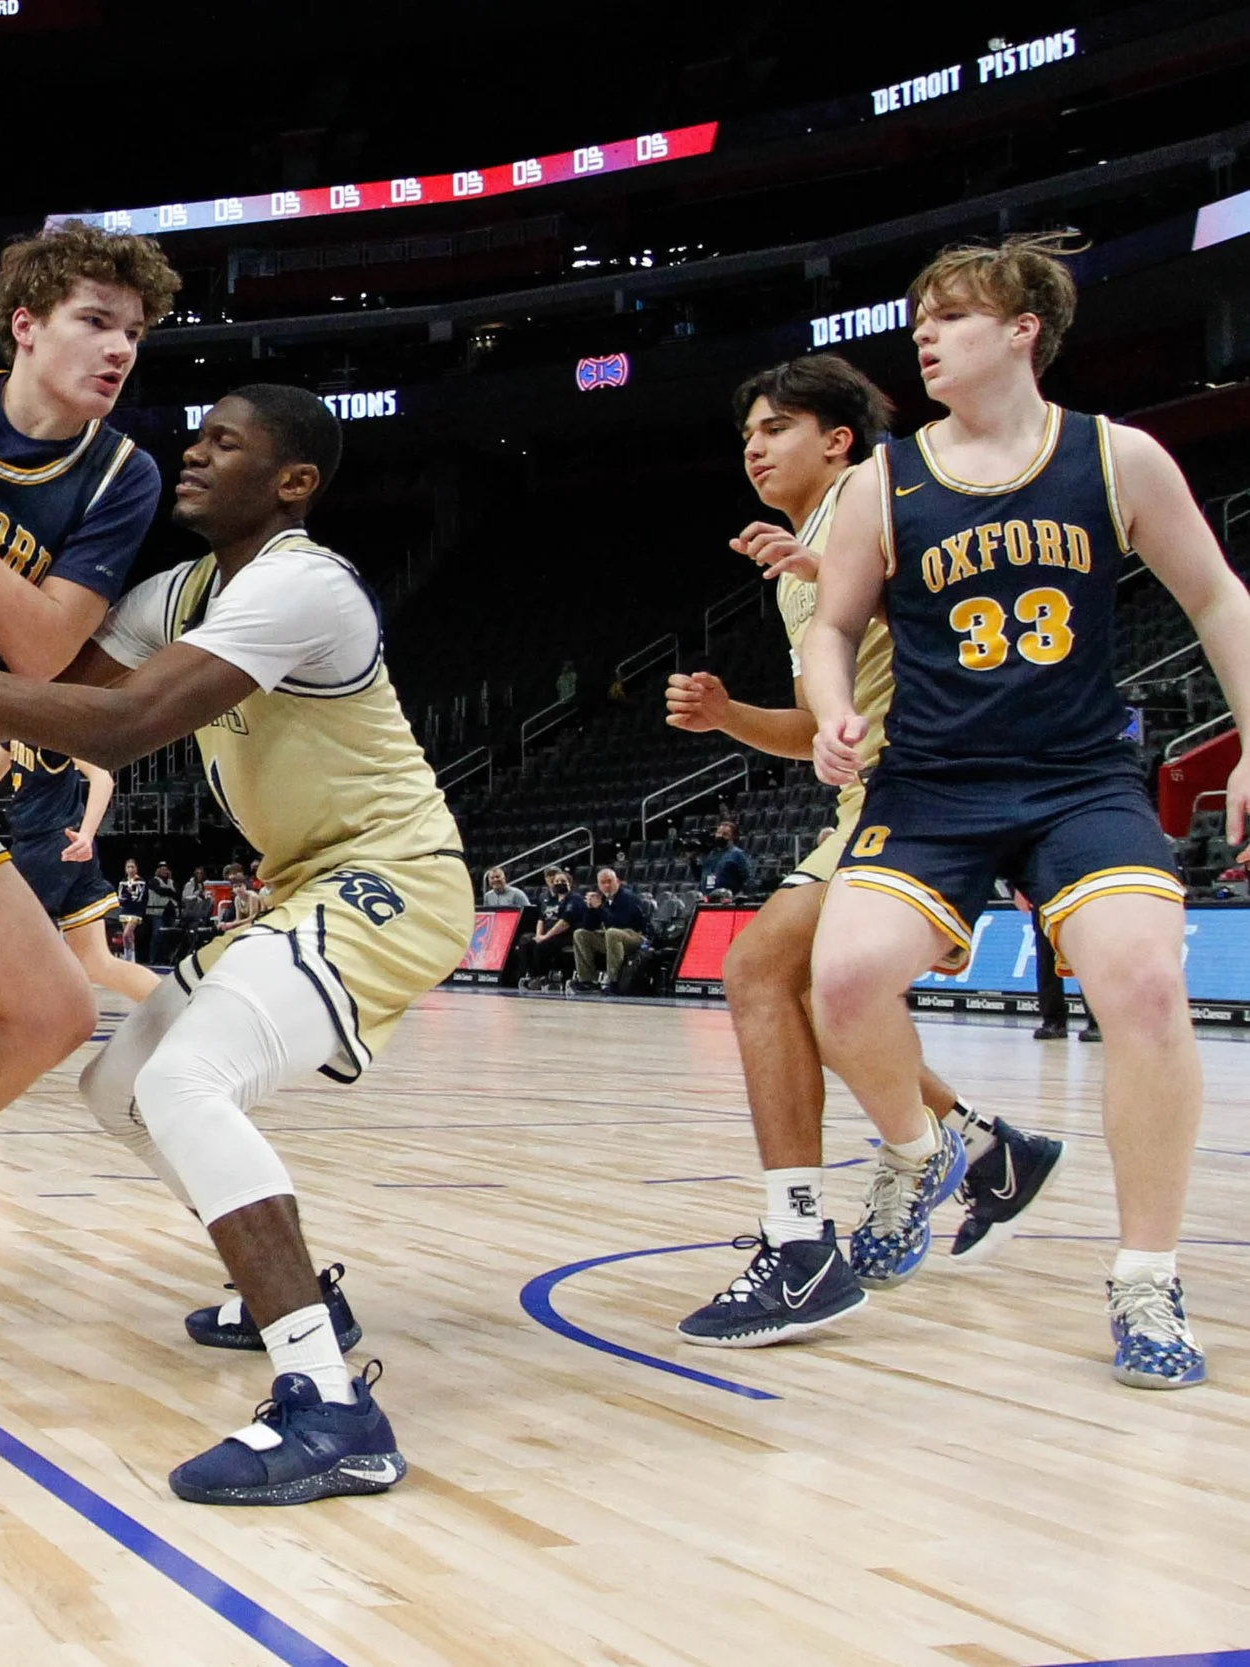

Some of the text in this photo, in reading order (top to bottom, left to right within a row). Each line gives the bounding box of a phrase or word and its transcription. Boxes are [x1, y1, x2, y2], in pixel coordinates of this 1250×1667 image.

[871, 28, 1076, 115] DETROIT PISTONS
[810, 298, 908, 347] DETROIT
[317, 390, 397, 421] STONS
[921, 519, 1092, 594] OXFORD
[949, 586, 1076, 671] 33
